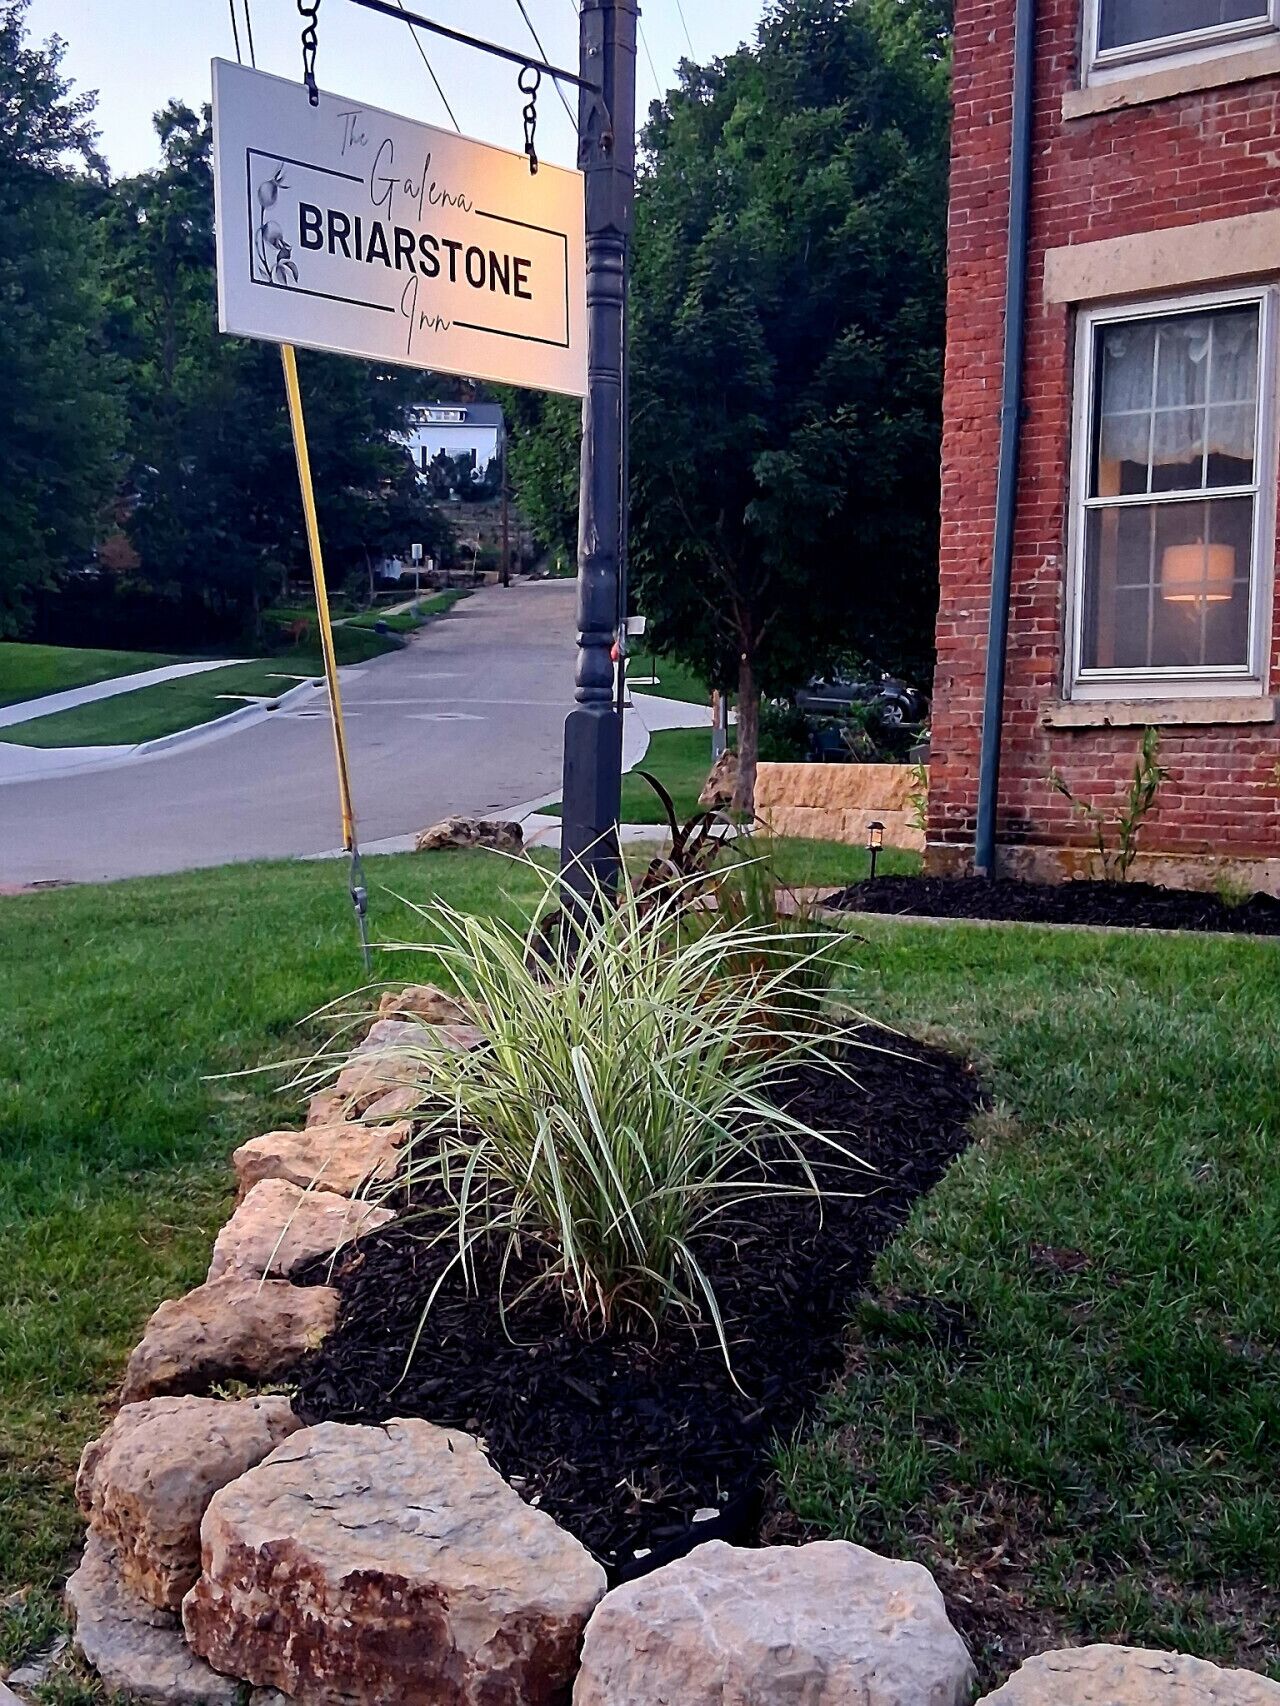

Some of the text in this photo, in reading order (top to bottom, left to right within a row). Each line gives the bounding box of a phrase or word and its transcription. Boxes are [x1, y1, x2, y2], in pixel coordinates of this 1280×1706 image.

[337, 110, 369, 156] The
[370, 138, 473, 222] Galena
[299, 201, 532, 300] BRIARSTONE
[400, 275, 451, 355] Inn
